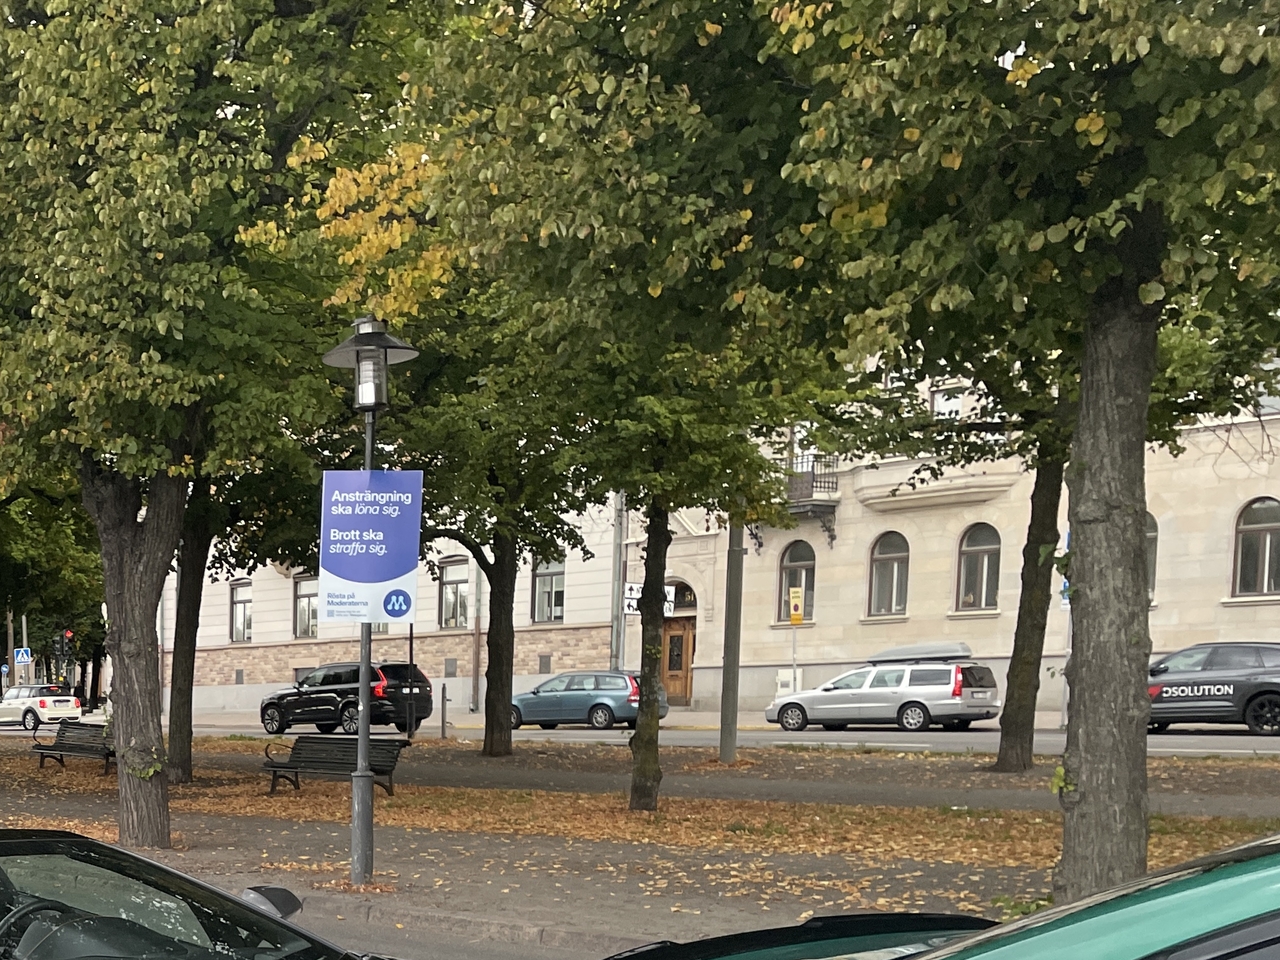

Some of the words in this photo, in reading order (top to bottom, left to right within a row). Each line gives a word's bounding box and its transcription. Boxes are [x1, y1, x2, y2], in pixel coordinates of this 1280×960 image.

[331, 490, 412, 504] Ansträngning
[331, 503, 352, 515] ska
[354, 503, 380, 515] löna
[382, 503, 401, 518] sig.
[330, 528, 361, 541] Brott
[362, 528, 384, 541] ska
[329, 542, 366, 556] straffa
[368, 542, 388, 556] sig.
[327, 592, 346, 600] Rösta
[346, 592, 356, 600] på
